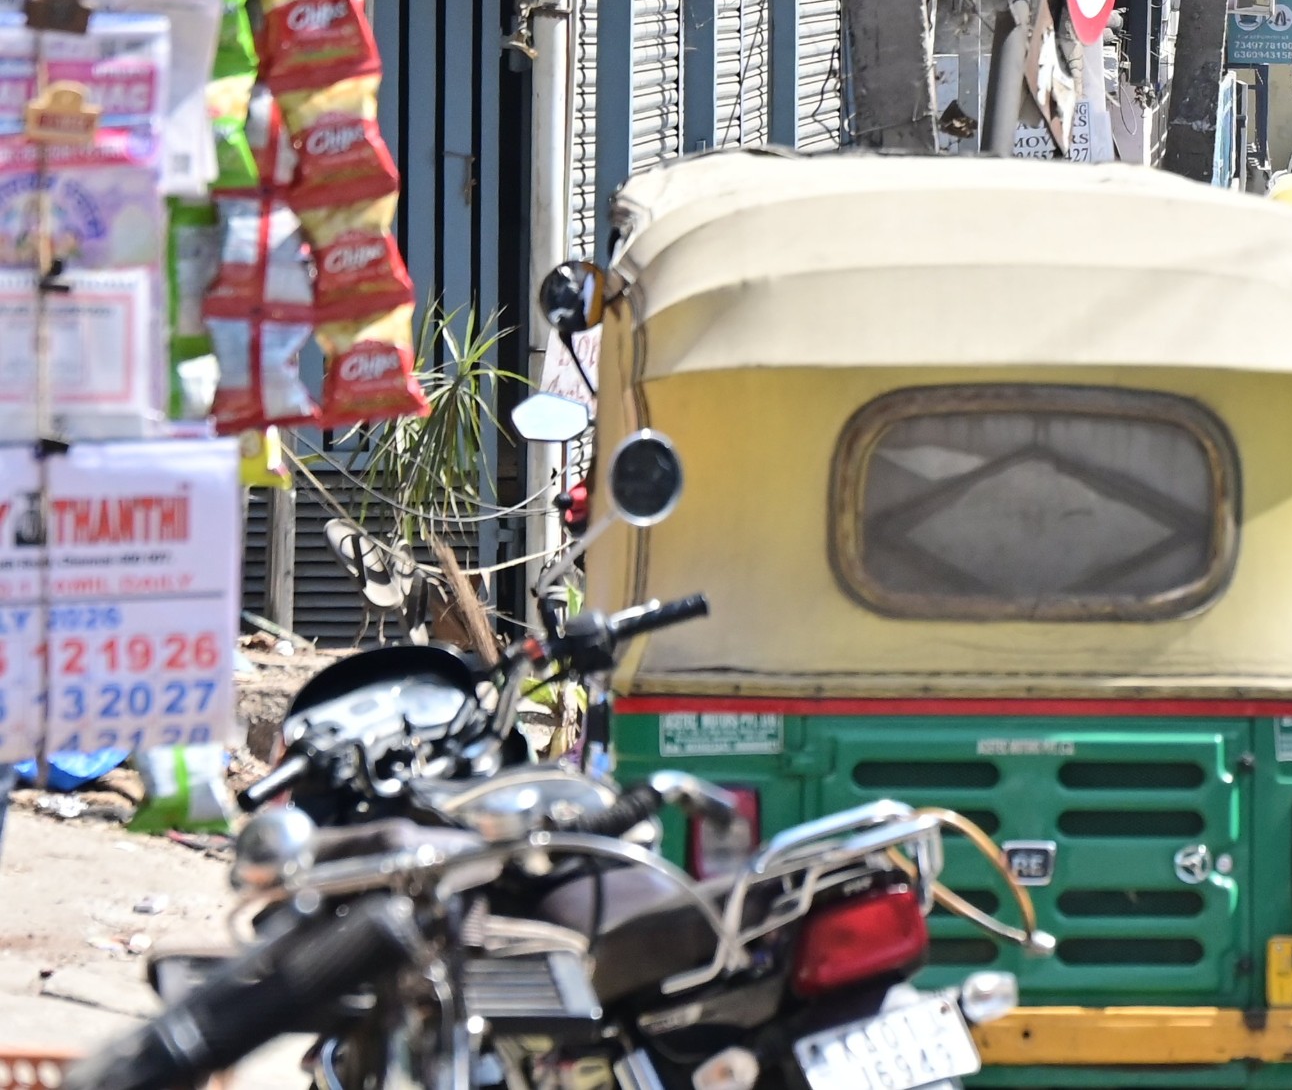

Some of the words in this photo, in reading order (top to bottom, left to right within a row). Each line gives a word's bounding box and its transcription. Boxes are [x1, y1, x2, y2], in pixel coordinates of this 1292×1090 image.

[288, 0, 347, 30] Chips
[340, 350, 401, 380] Chips
[102, 636, 153, 672] 19
[163, 631, 219, 669] 26
[99, 684, 153, 718] 20
[165, 680, 215, 715] 27
